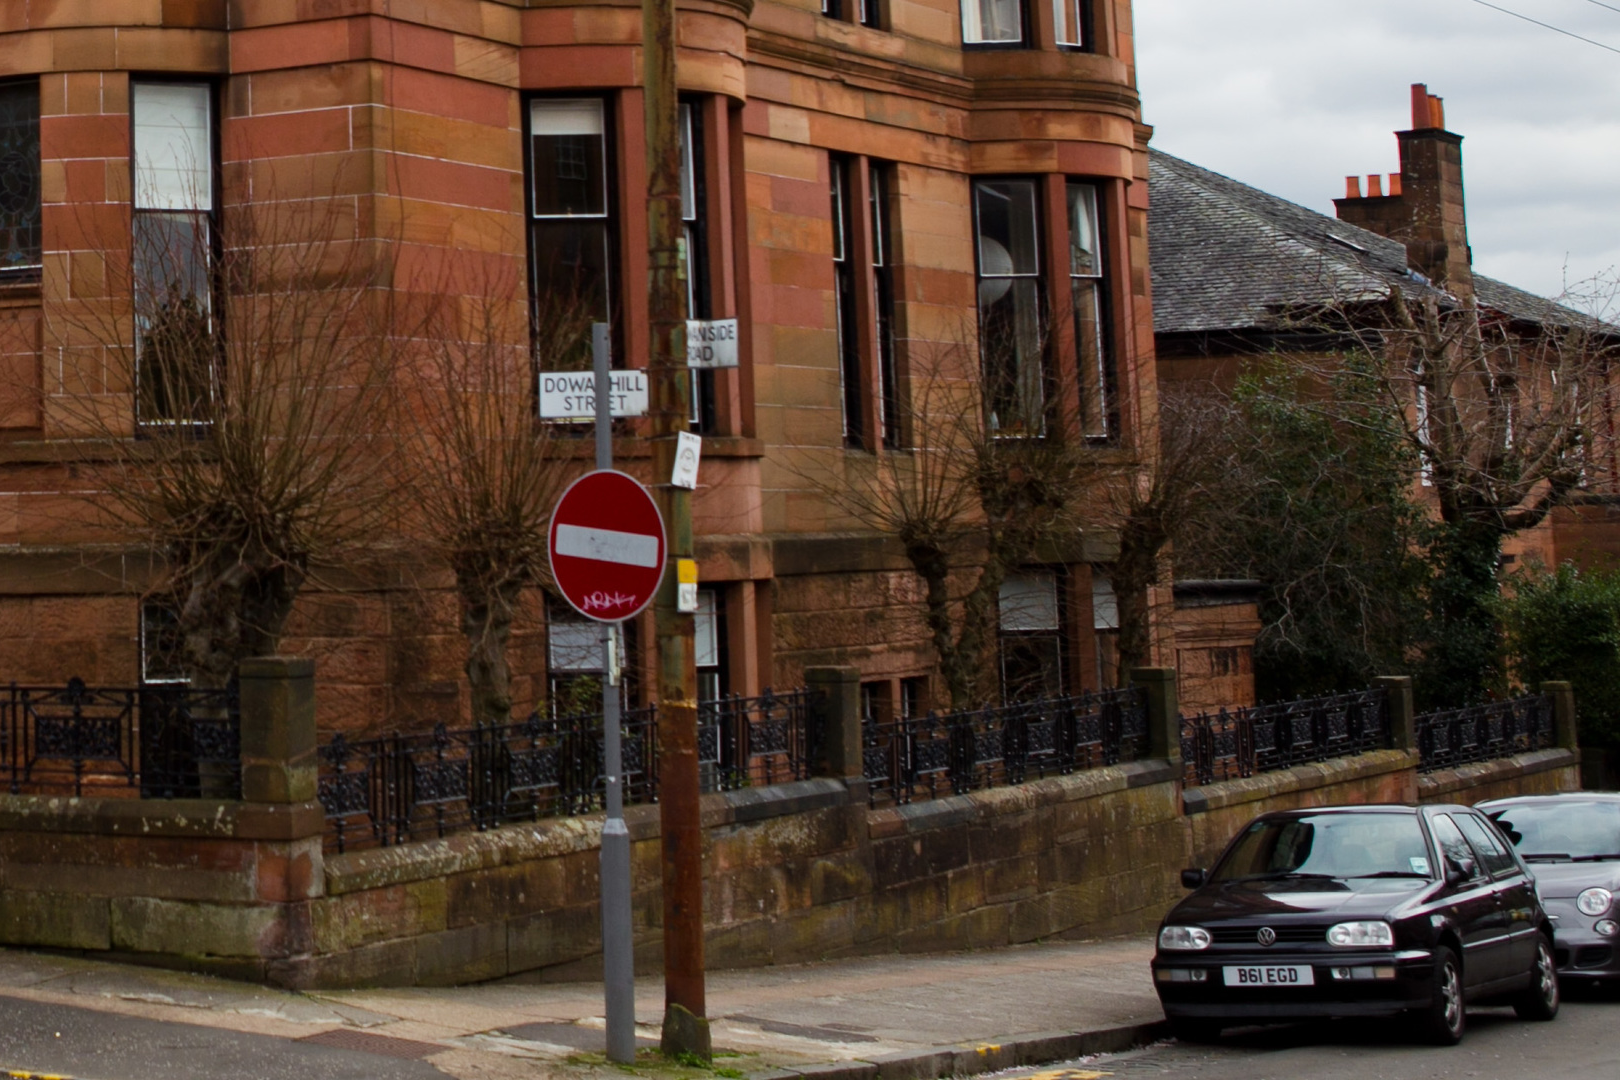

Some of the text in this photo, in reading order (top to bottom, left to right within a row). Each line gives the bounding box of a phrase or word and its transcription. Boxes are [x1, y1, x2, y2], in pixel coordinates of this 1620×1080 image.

[544, 376, 643, 393] DOWAHILL
[563, 394, 628, 411] STRET
[1237, 967, 1298, 983] B61 EGD
